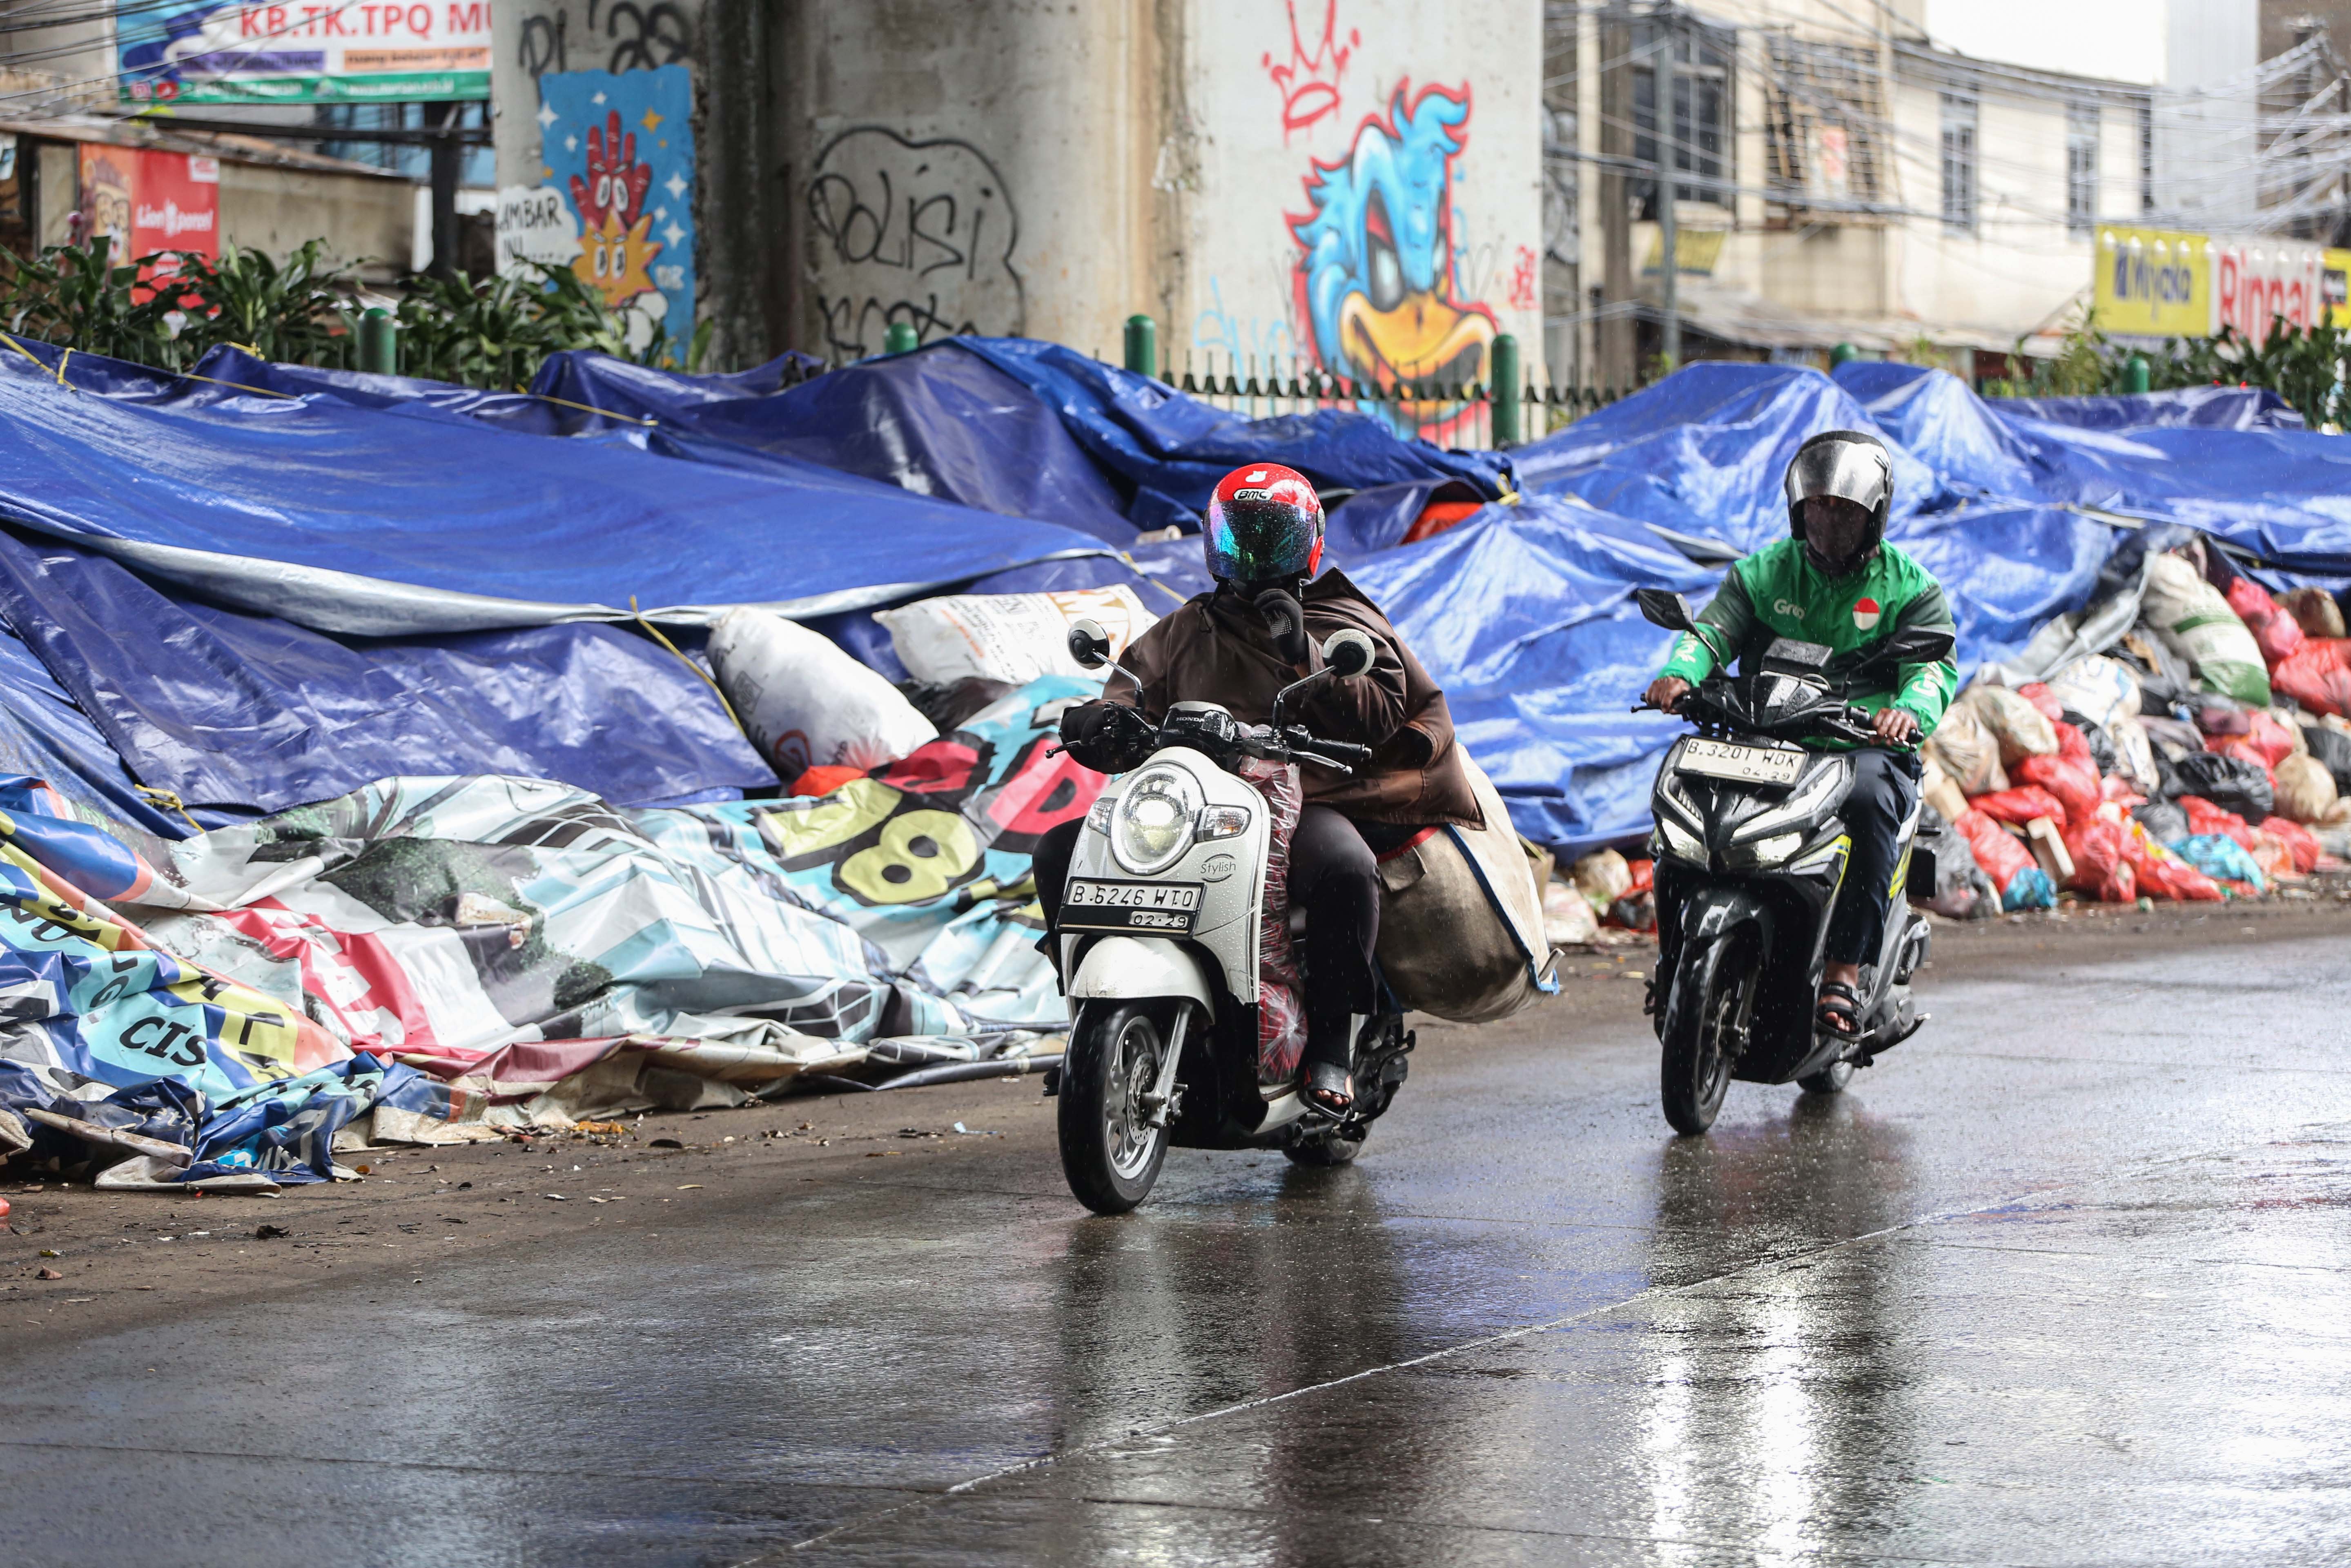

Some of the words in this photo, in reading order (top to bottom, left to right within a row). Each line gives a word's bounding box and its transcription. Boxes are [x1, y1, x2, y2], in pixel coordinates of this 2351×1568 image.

[241, 4, 431, 40] KB.TK.TPQ
[497, 197, 561, 231] AMBAR
[1237, 491, 1268, 500] BMC
[1201, 862, 1236, 875] Stylish
